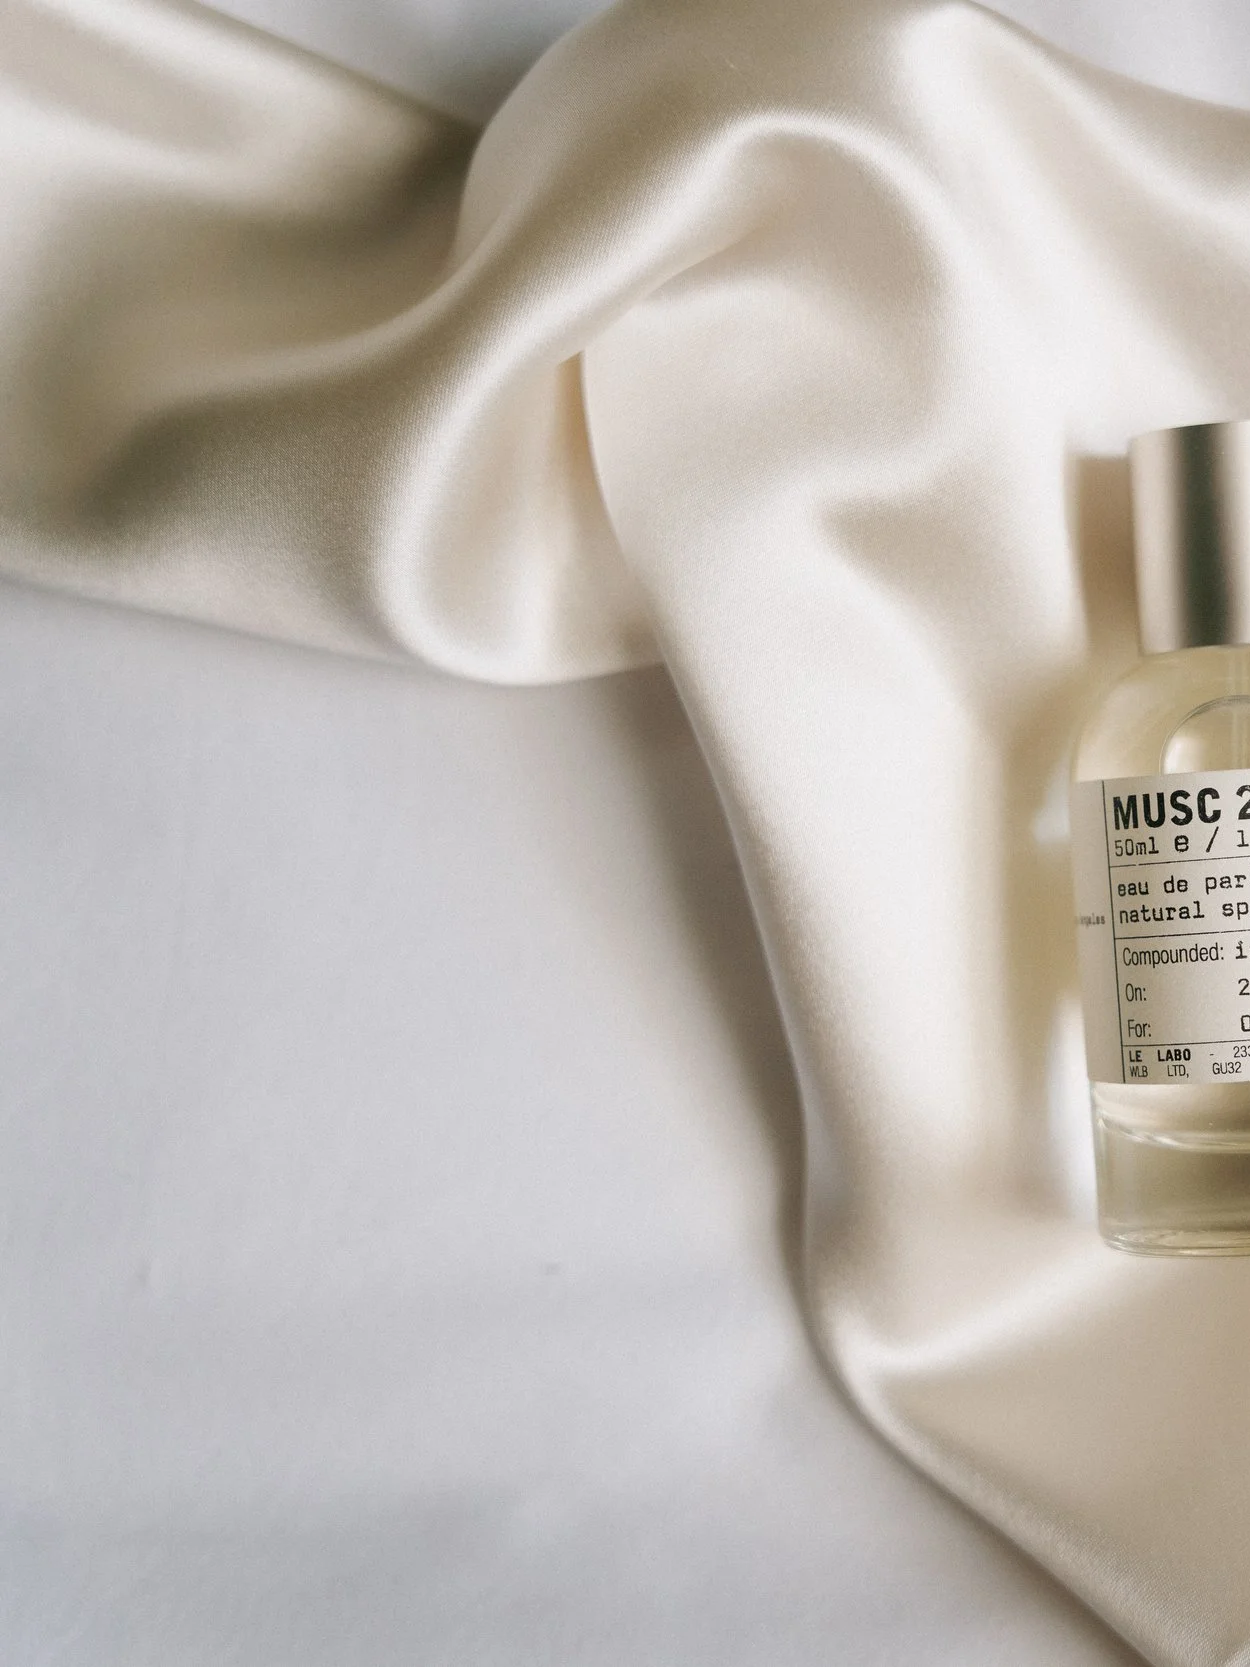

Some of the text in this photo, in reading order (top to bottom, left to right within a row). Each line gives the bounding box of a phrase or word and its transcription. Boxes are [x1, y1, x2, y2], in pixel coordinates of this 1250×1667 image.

[1112, 787, 1222, 830] MUSC
[1114, 835, 1159, 857] 50ml
[1205, 825, 1220, 853] /
[1117, 881, 1150, 897] eau
[1163, 874, 1189, 893] de
[1119, 900, 1205, 924] natural
[1122, 943, 1225, 968] Compounded:
[1125, 983, 1147, 1002] On:
[1127, 1019, 1152, 1038] For:
[1128, 1050, 1143, 1063] LE
[1157, 1048, 1192, 1062] LABO
[1129, 1065, 1149, 1078] WLB
[1167, 1064, 1190, 1079] LTD,
[1212, 1061, 1242, 1075] GU32
